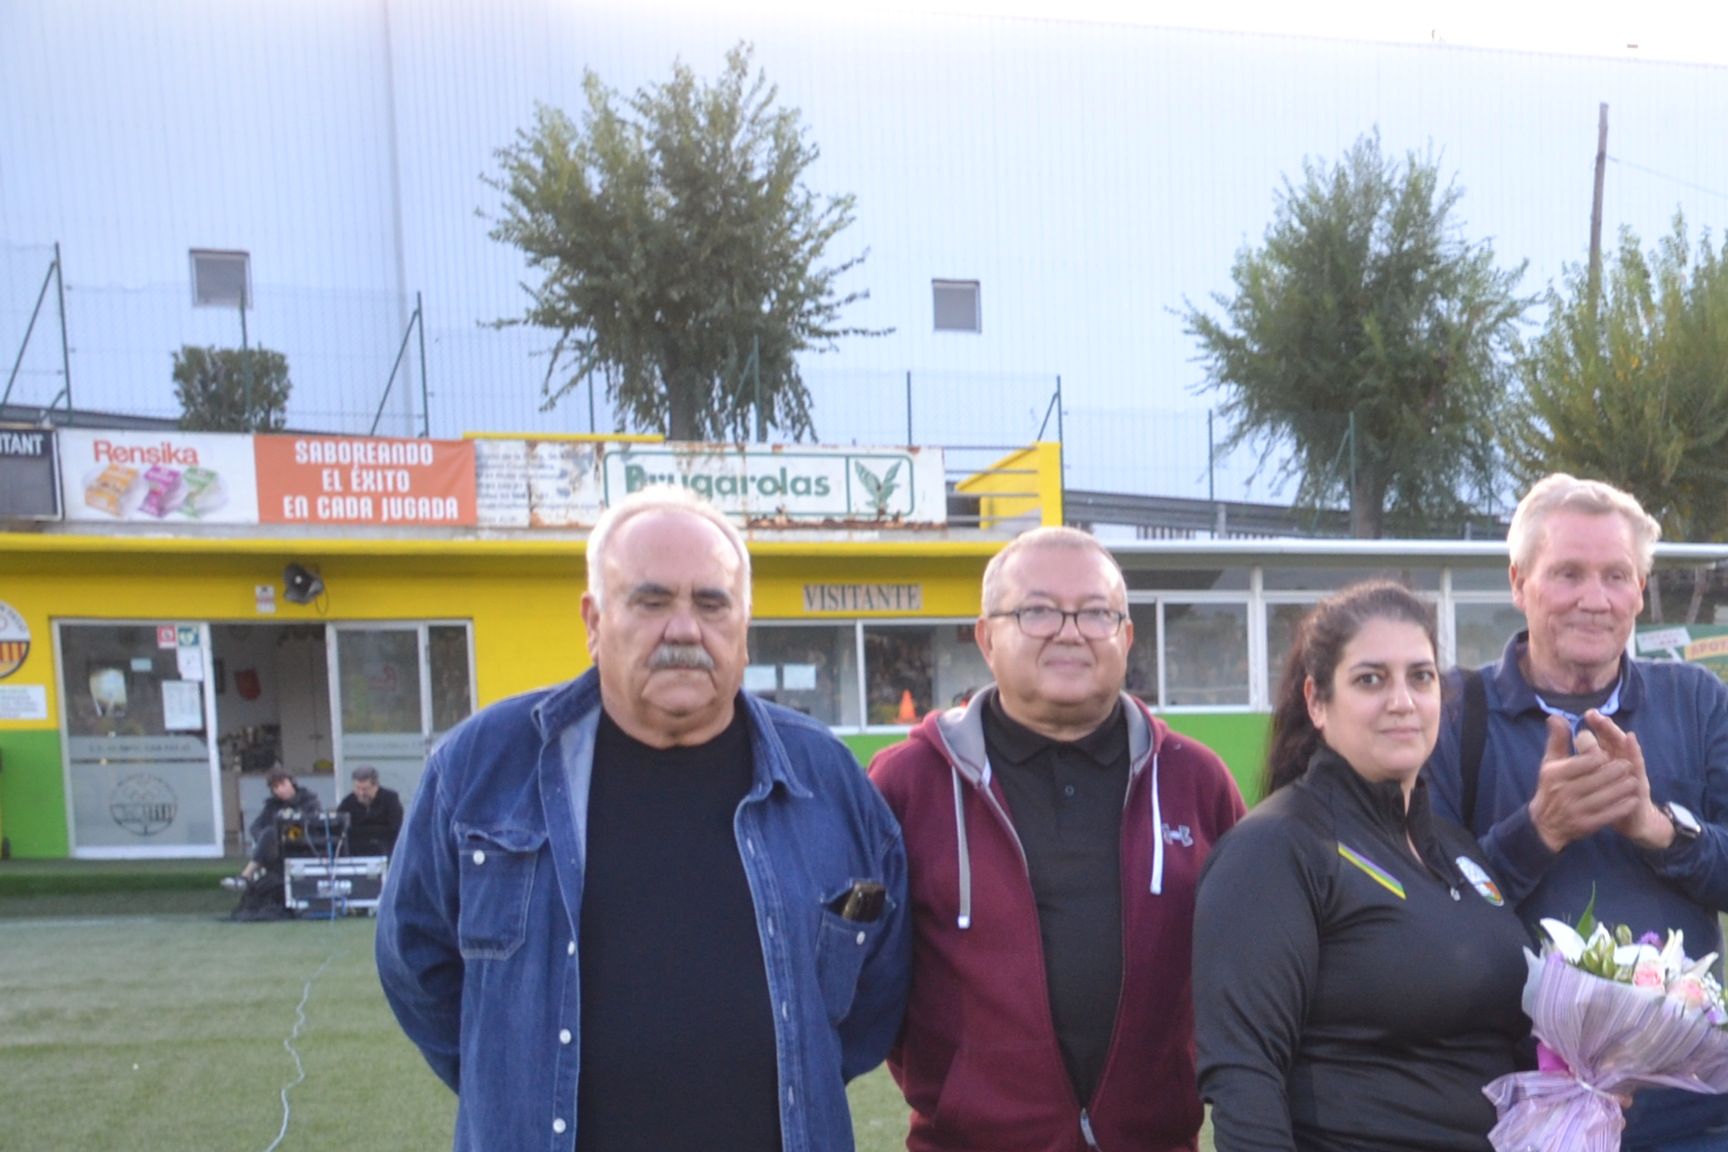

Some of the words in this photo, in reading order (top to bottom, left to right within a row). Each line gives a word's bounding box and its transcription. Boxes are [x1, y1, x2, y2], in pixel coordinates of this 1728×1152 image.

[93, 439, 199, 464] Rensika
[295, 441, 433, 466] SABOREANDO
[322, 468, 343, 492] EL
[351, 464, 410, 493] ÉXITO
[283, 496, 308, 519] EN
[317, 496, 373, 519] CADA
[381, 497, 459, 522] JUGADA
[803, 585, 921, 611] VISITANTE
